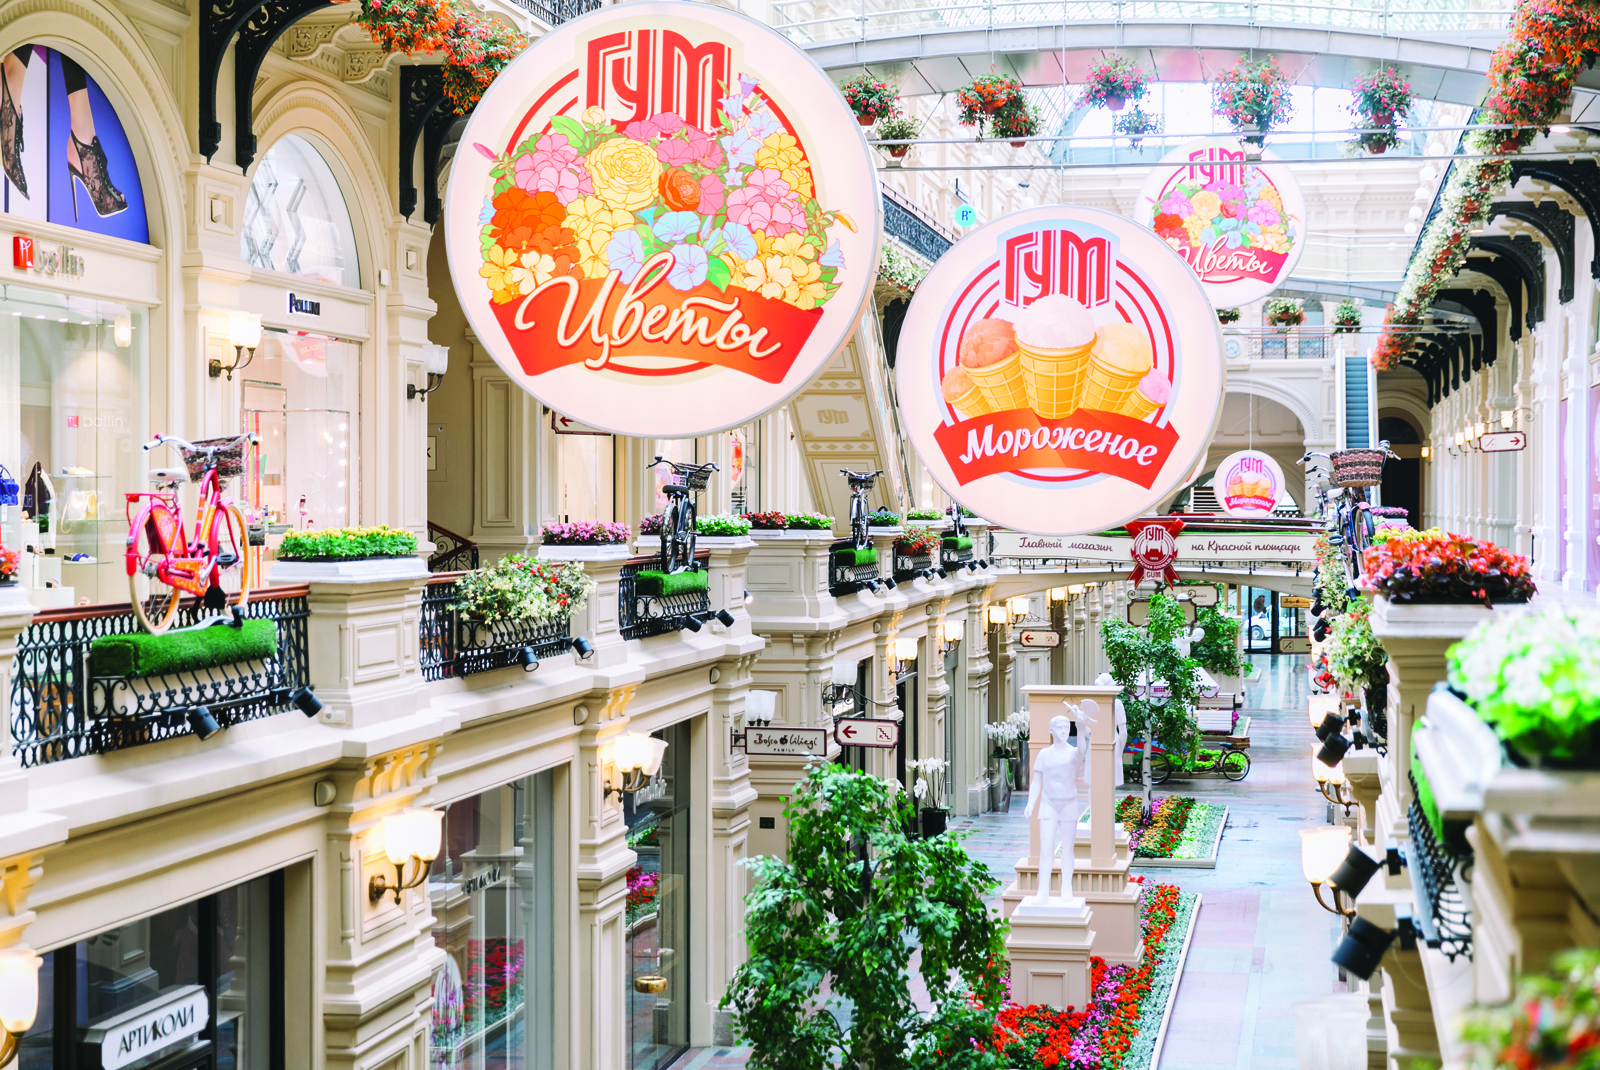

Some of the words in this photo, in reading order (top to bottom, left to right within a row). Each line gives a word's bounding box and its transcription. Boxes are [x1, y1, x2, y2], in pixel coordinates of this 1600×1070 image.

[586, 29, 731, 134] ГУМ
[1005, 229, 1112, 309] ГУМ
[515, 252, 782, 370] Цветы
[83, 416, 123, 428] ballin
[959, 423, 1158, 466] Мороженое
[1019, 537, 1062, 549] Главный
[1068, 542, 1113, 552] магазин
[1207, 540, 1252, 554] Красной
[1254, 544, 1301, 554] площади
[118, 1003, 195, 1058] АРТИКОЛИ
